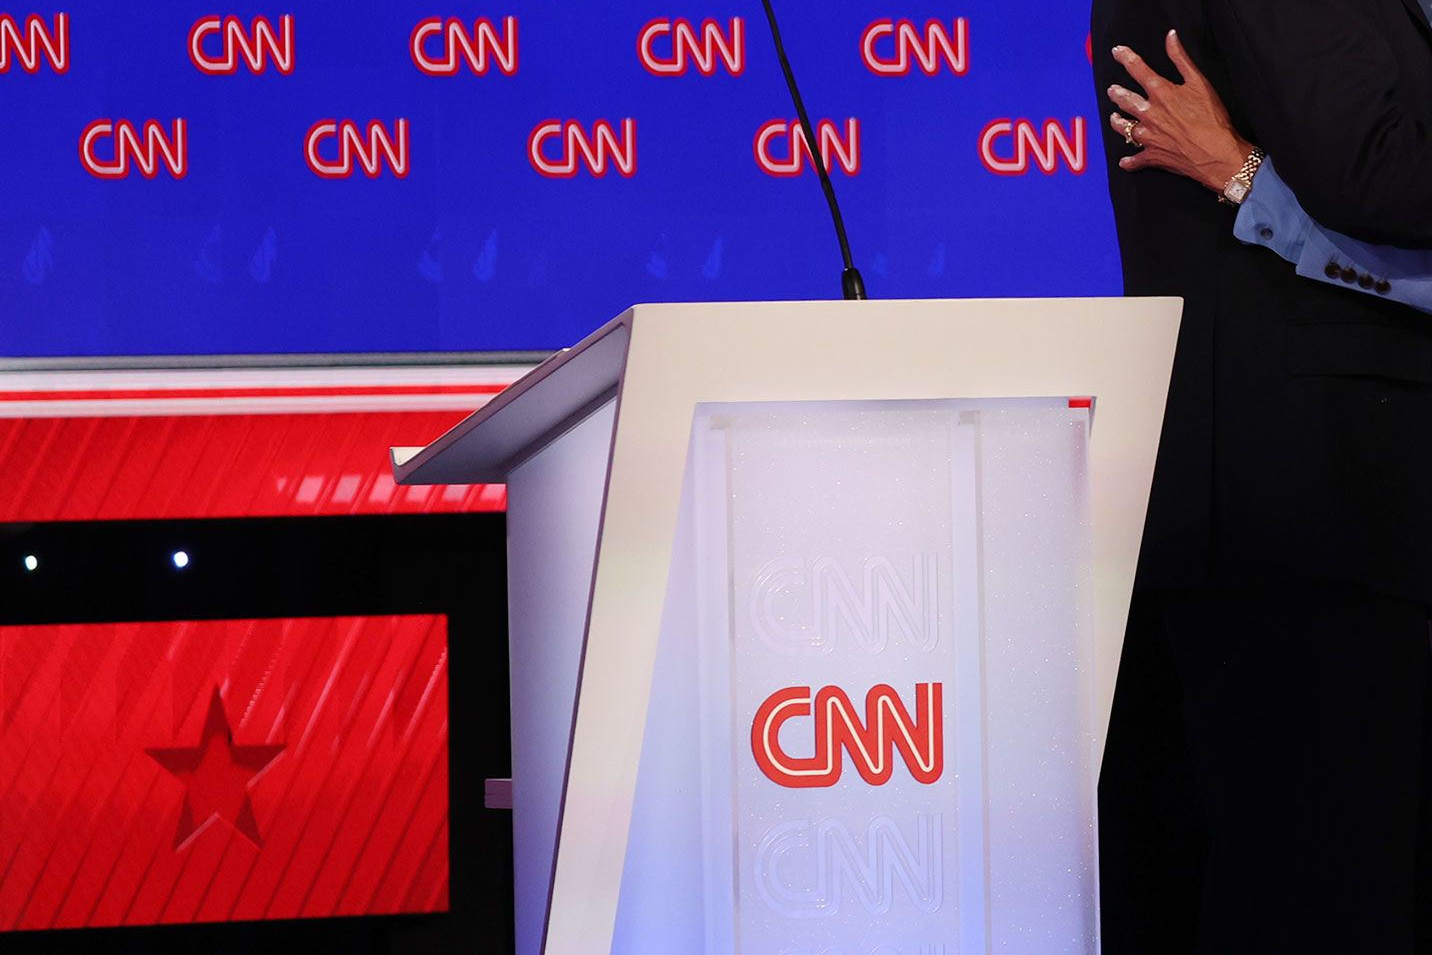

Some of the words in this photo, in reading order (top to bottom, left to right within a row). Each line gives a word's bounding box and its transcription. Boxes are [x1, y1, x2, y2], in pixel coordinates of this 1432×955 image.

[0, 11, 70, 75] NN
[188, 14, 295, 76] CNN
[409, 15, 519, 77] CNN
[636, 16, 745, 78] CNN
[860, 17, 970, 77] CNN
[79, 117, 188, 180] CNN
[304, 118, 411, 180] CNN
[527, 117, 637, 180] CNN
[753, 117, 862, 178] CNN
[976, 115, 1088, 177] CNN
[749, 552, 939, 654] CNN
[751, 682, 943, 788] CNN
[753, 813, 944, 918] CNN
